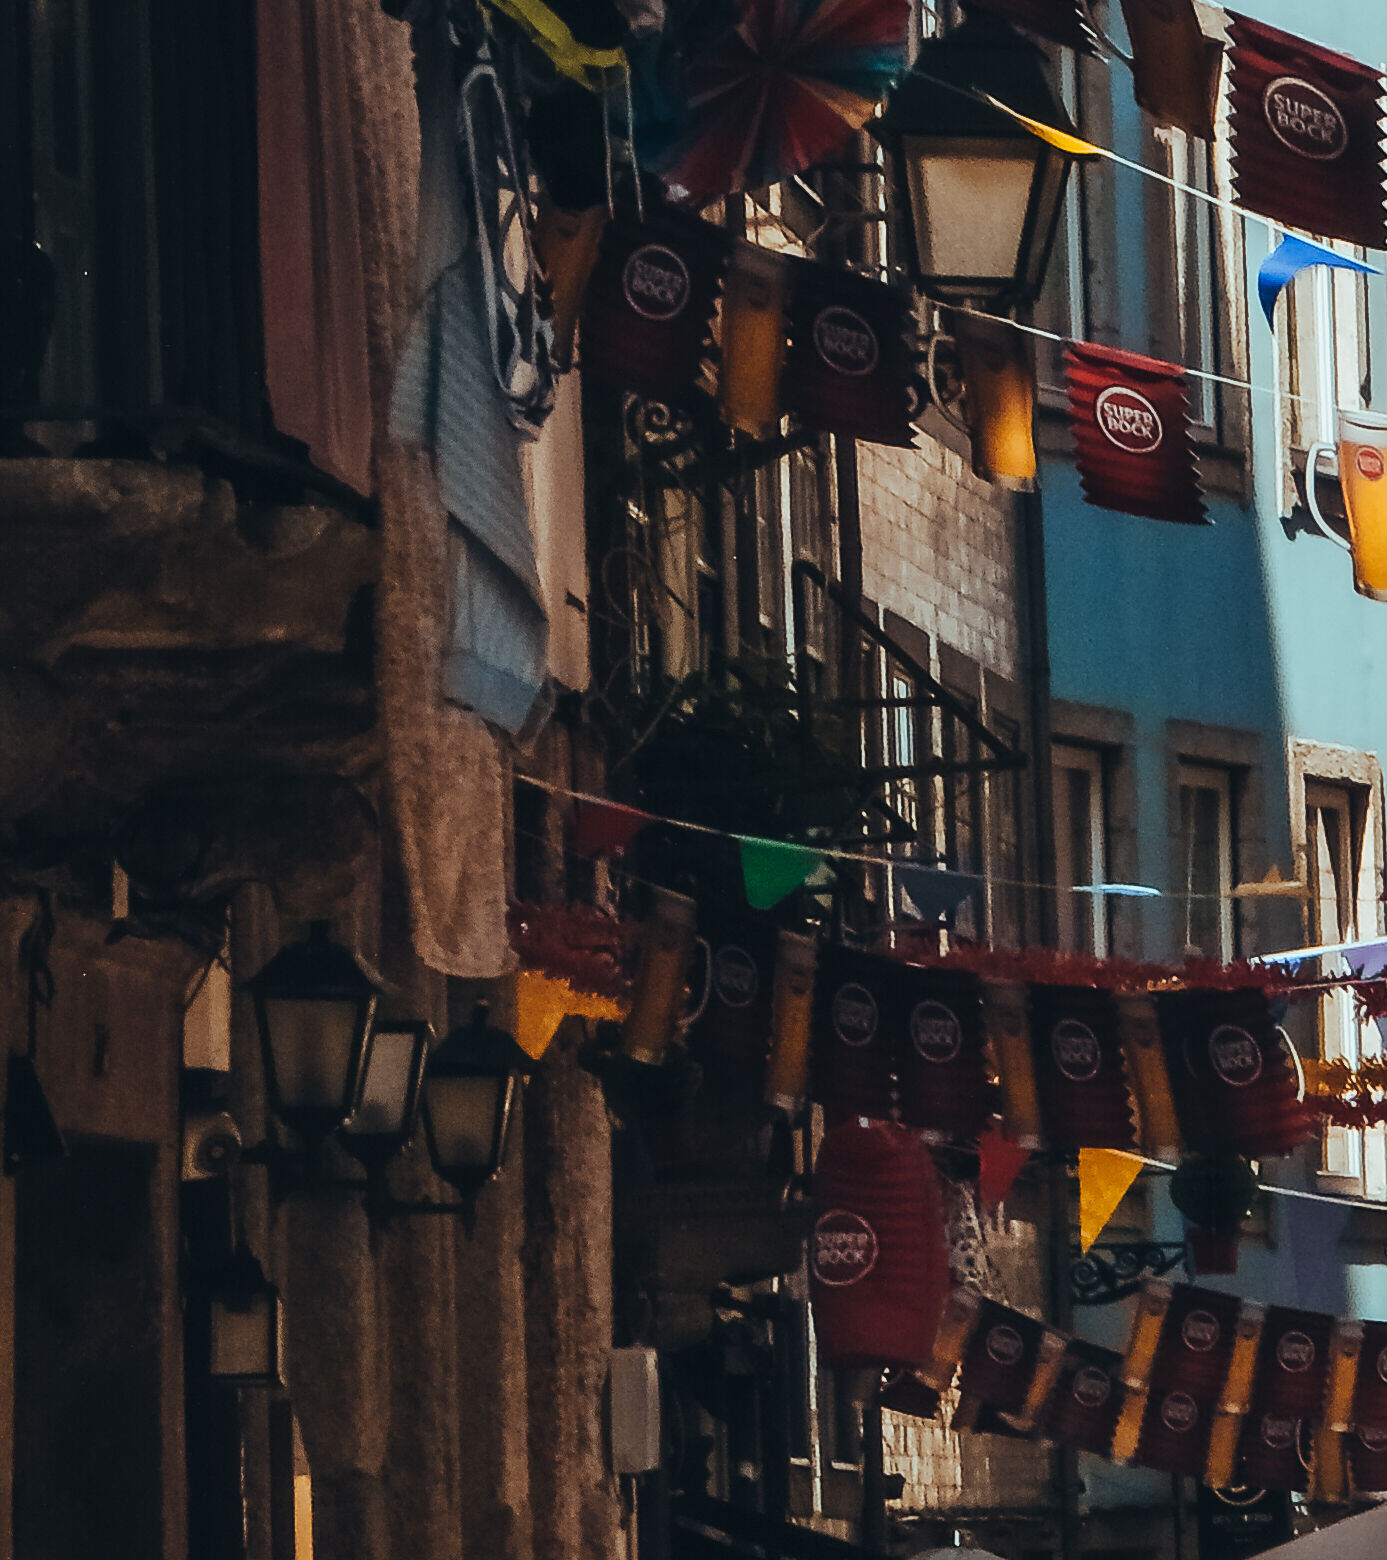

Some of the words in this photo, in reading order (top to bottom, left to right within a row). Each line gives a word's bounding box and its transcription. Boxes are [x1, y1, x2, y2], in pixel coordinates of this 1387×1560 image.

[1273, 92, 1336, 127] SUPER
[1278, 108, 1335, 144] BOCK
[1103, 402, 1153, 426] SUPER
[1108, 417, 1153, 440] BOCK
